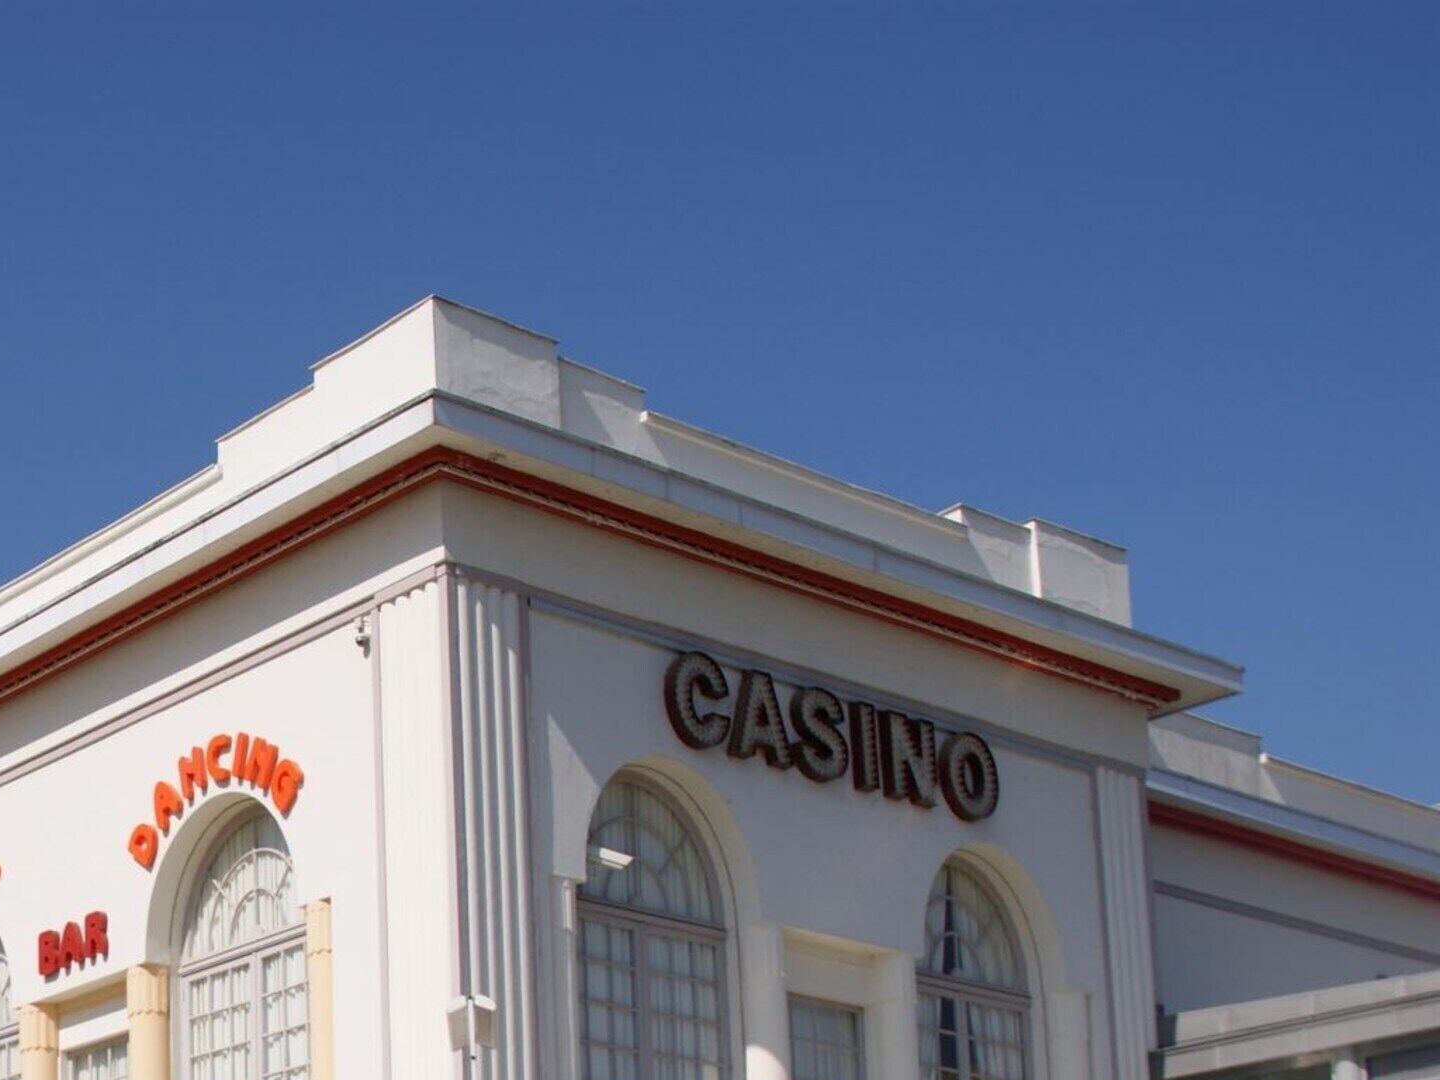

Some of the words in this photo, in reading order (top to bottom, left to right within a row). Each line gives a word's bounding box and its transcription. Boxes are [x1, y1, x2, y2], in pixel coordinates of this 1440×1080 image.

[127, 732, 304, 870] DANCING
[664, 651, 999, 822] CASINO
[38, 911, 109, 977] BAR
